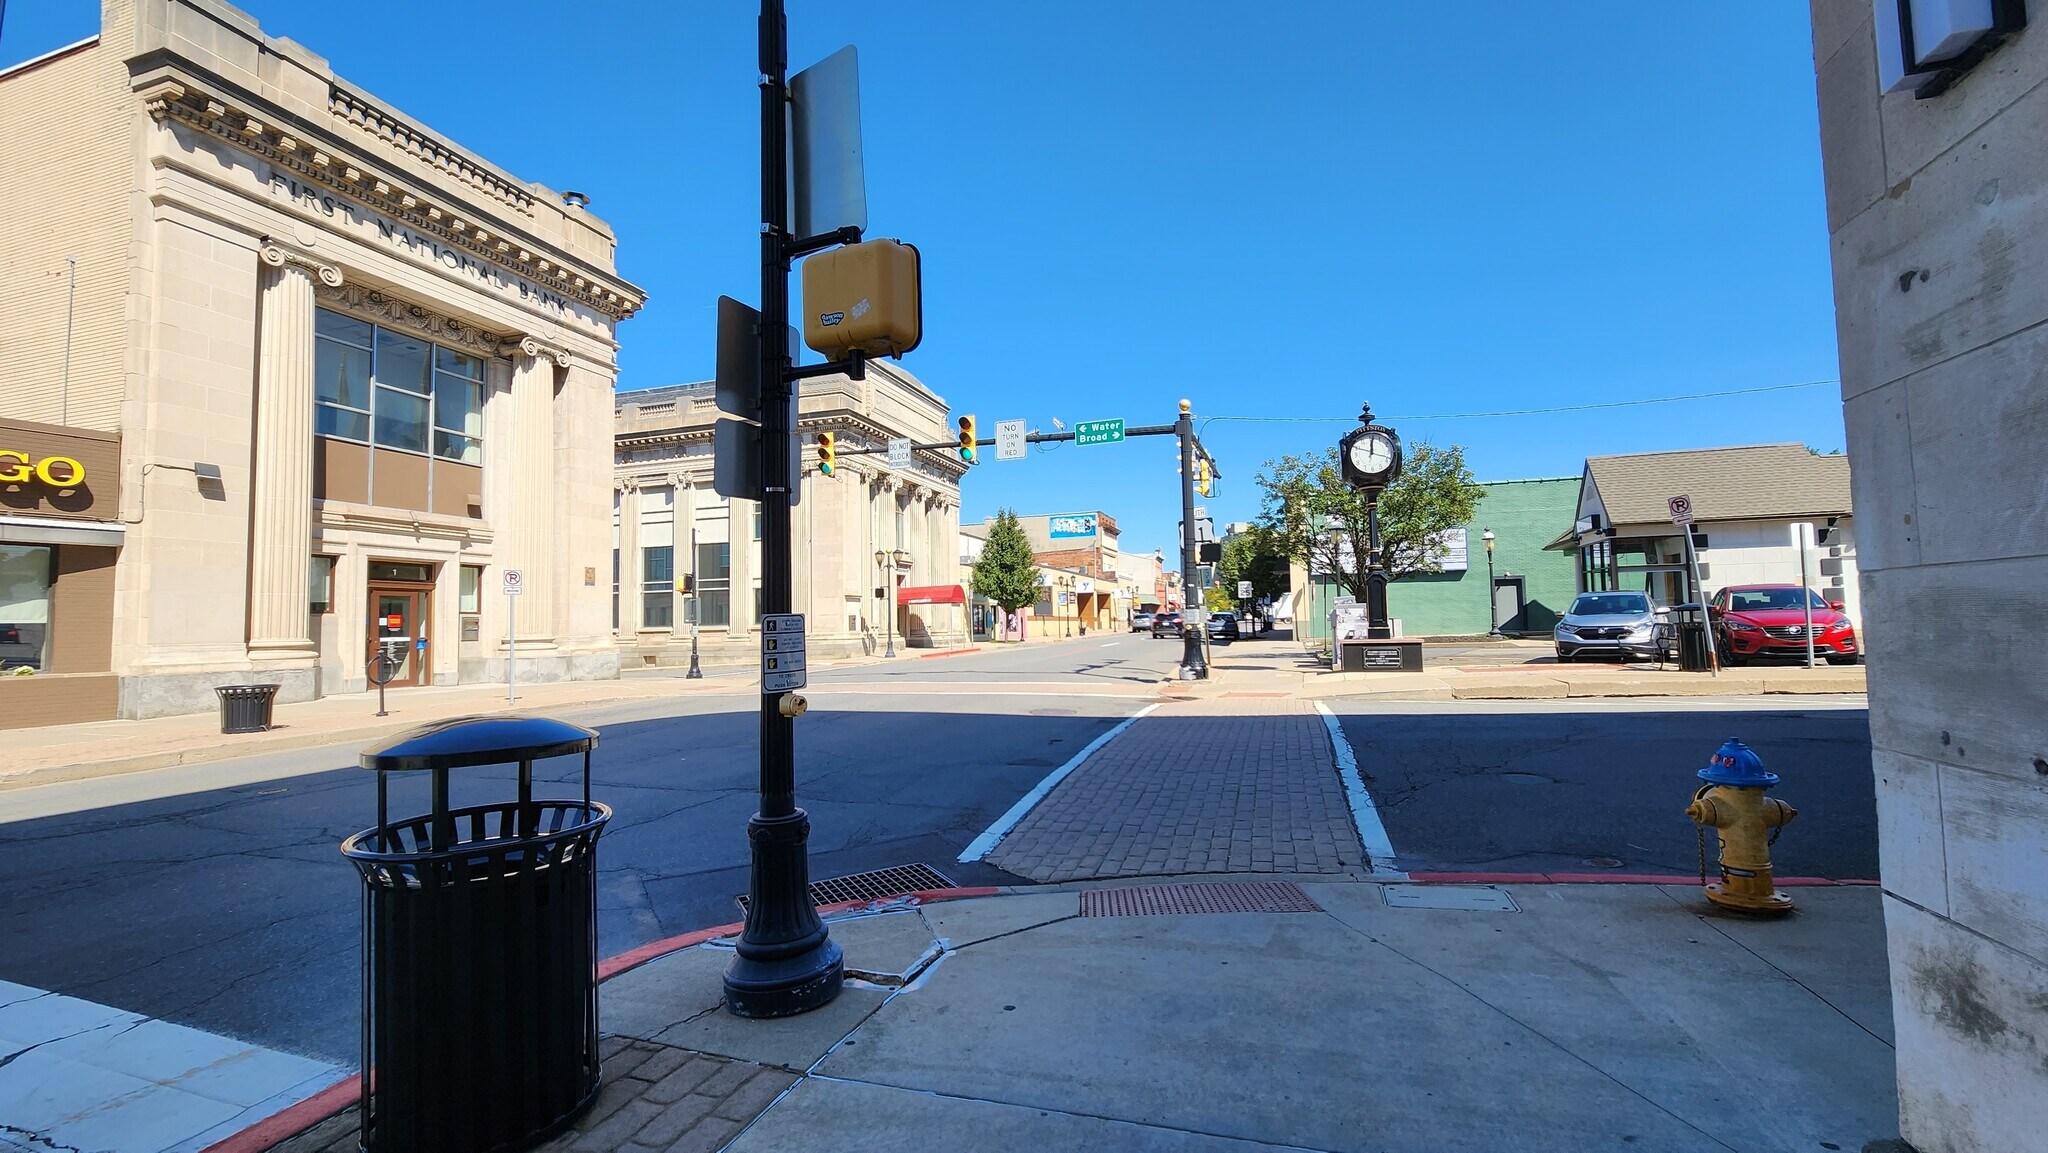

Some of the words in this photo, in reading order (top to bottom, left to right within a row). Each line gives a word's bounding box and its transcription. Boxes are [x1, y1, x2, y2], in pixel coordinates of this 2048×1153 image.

[270, 171, 355, 225] FIRST
[376, 218, 503, 290] NATIONAL
[519, 281, 567, 317] BANK
[1003, 424, 1017, 432] NO
[1091, 422, 1120, 431] Water
[1080, 433, 1107, 443] Broad
[889, 443, 897, 451] DO
[898, 442, 909, 450] NOT
[890, 452, 910, 460] BLOCK
[0, 450, 85, 487] GO
